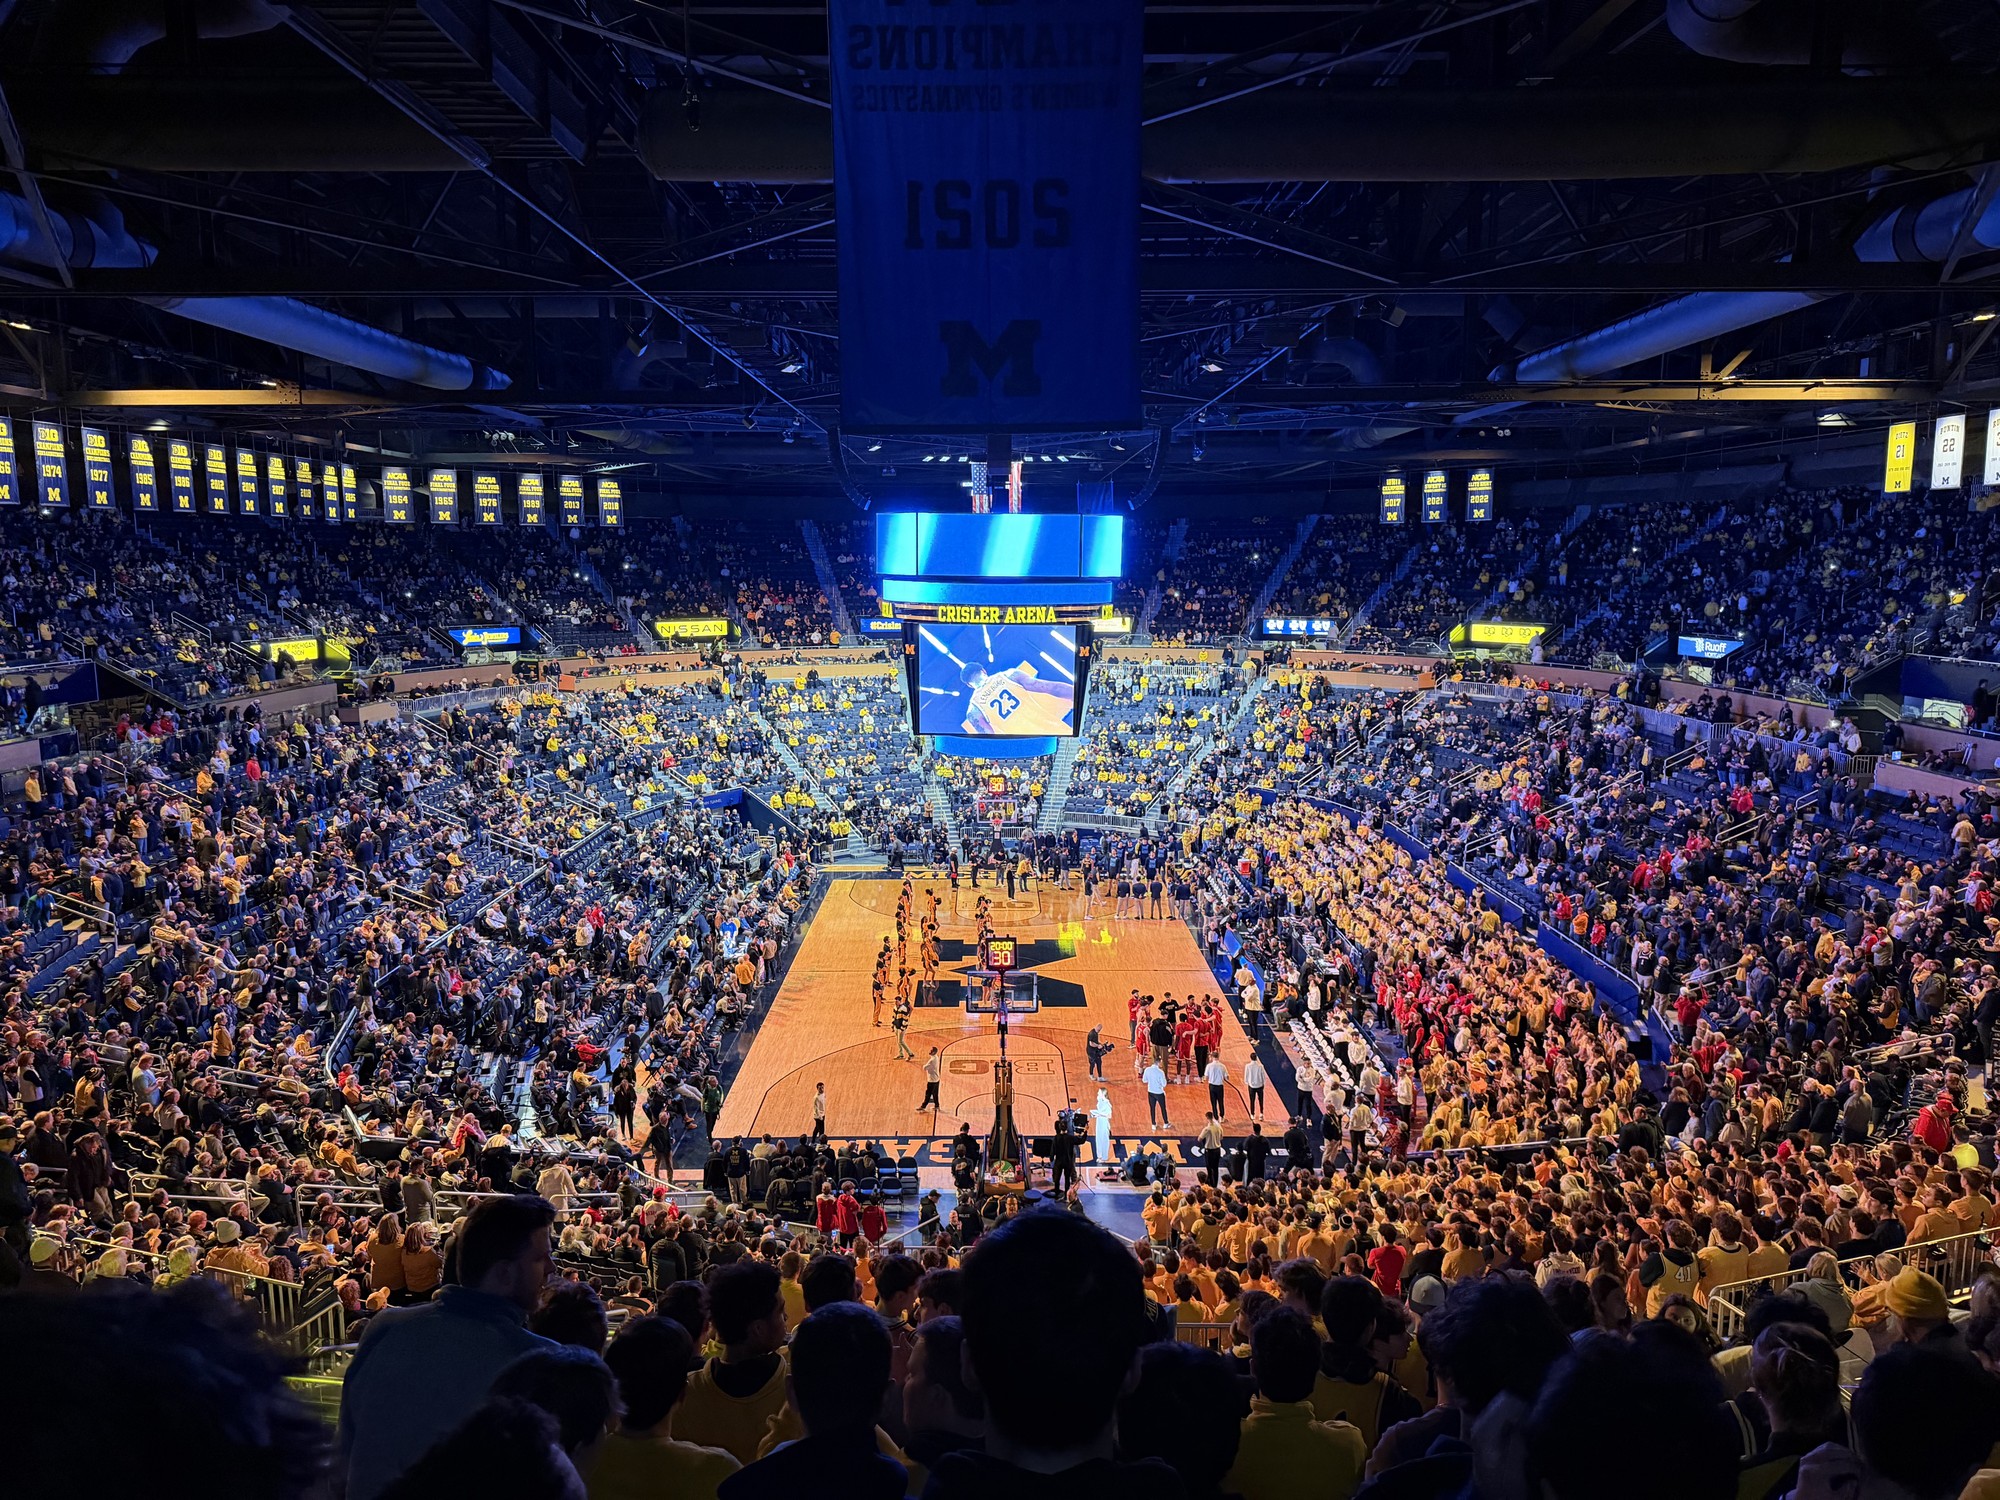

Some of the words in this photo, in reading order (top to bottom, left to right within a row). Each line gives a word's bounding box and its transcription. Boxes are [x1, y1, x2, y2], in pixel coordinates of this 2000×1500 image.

[1942, 438, 1956, 453] 22
[1896, 445, 1905, 458] 21
[0, 461, 11, 474] 66
[42, 464, 62, 478] 1974
[90, 469, 108, 482] 1977
[387, 473, 408, 481] NCAA
[432, 474, 453, 482] NCAA
[477, 476, 496, 484] NCAA
[1942, 476, 1950, 485] M
[1894, 481, 1902, 489] M
[48, 487, 61, 501] M
[95, 491, 108, 504] M
[1470, 495, 1489, 503] 2022
[140, 493, 151, 506] M
[179, 495, 189, 508] M
[214, 498, 224, 510] M
[388, 495, 408, 504] 1964
[434, 496, 454, 505] 1965
[479, 498, 497, 507] 1976
[523, 500, 540, 508] 1989
[1384, 498, 1401, 507] 2017
[1427, 497, 1443, 505] 2021
[245, 500, 255, 511] M
[275, 502, 284, 513] M
[303, 505, 311, 515] M
[564, 501, 580, 509] 2013
[329, 507, 337, 518] M
[348, 508, 355, 518] M
[393, 510, 406, 520] M
[438, 511, 451, 521] M
[483, 512, 495, 522] M
[1387, 512, 1398, 521] M
[1429, 511, 1440, 520] M
[1473, 509, 1485, 518] M
[526, 514, 538, 523] M
[567, 515, 578, 523] M
[606, 515, 618, 524] M
[938, 606, 1000, 624] CRISLER
[1004, 606, 1057, 624] ARENA
[660, 624, 723, 634] NISSAN
[905, 644, 915, 655] M
[1080, 646, 1089, 657] M
[1705, 642, 1727, 652] Ruoff
[990, 689, 1021, 720] 23
[990, 942, 1013, 950] 20:00
[994, 951, 1010, 965] 30
[949, 1059, 1055, 1076] BG
[1675, 1266, 1691, 1282] 41
